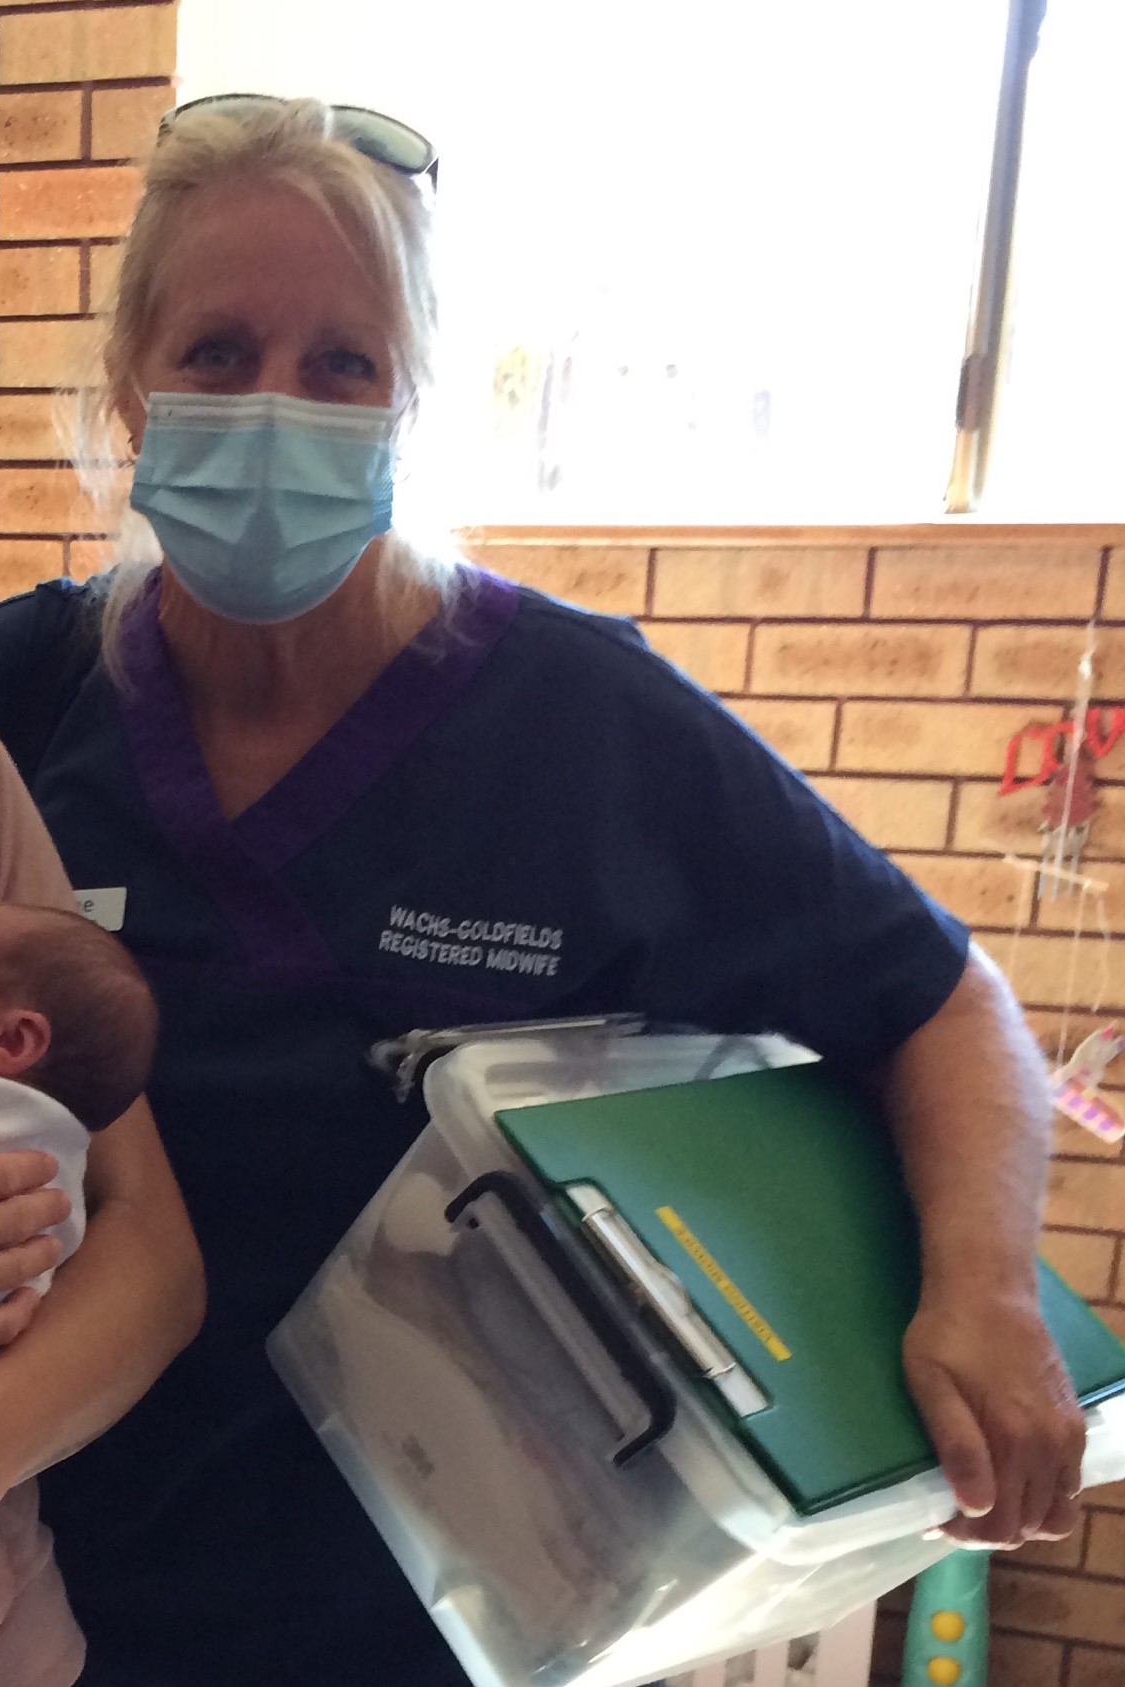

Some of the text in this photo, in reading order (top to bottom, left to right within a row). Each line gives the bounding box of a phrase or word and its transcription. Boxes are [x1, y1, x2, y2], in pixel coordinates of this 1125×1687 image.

[389, 904, 564, 950] WACHS-GOLDFIELDS
[378, 930, 562, 977] REGISTERED MIDWIFE
